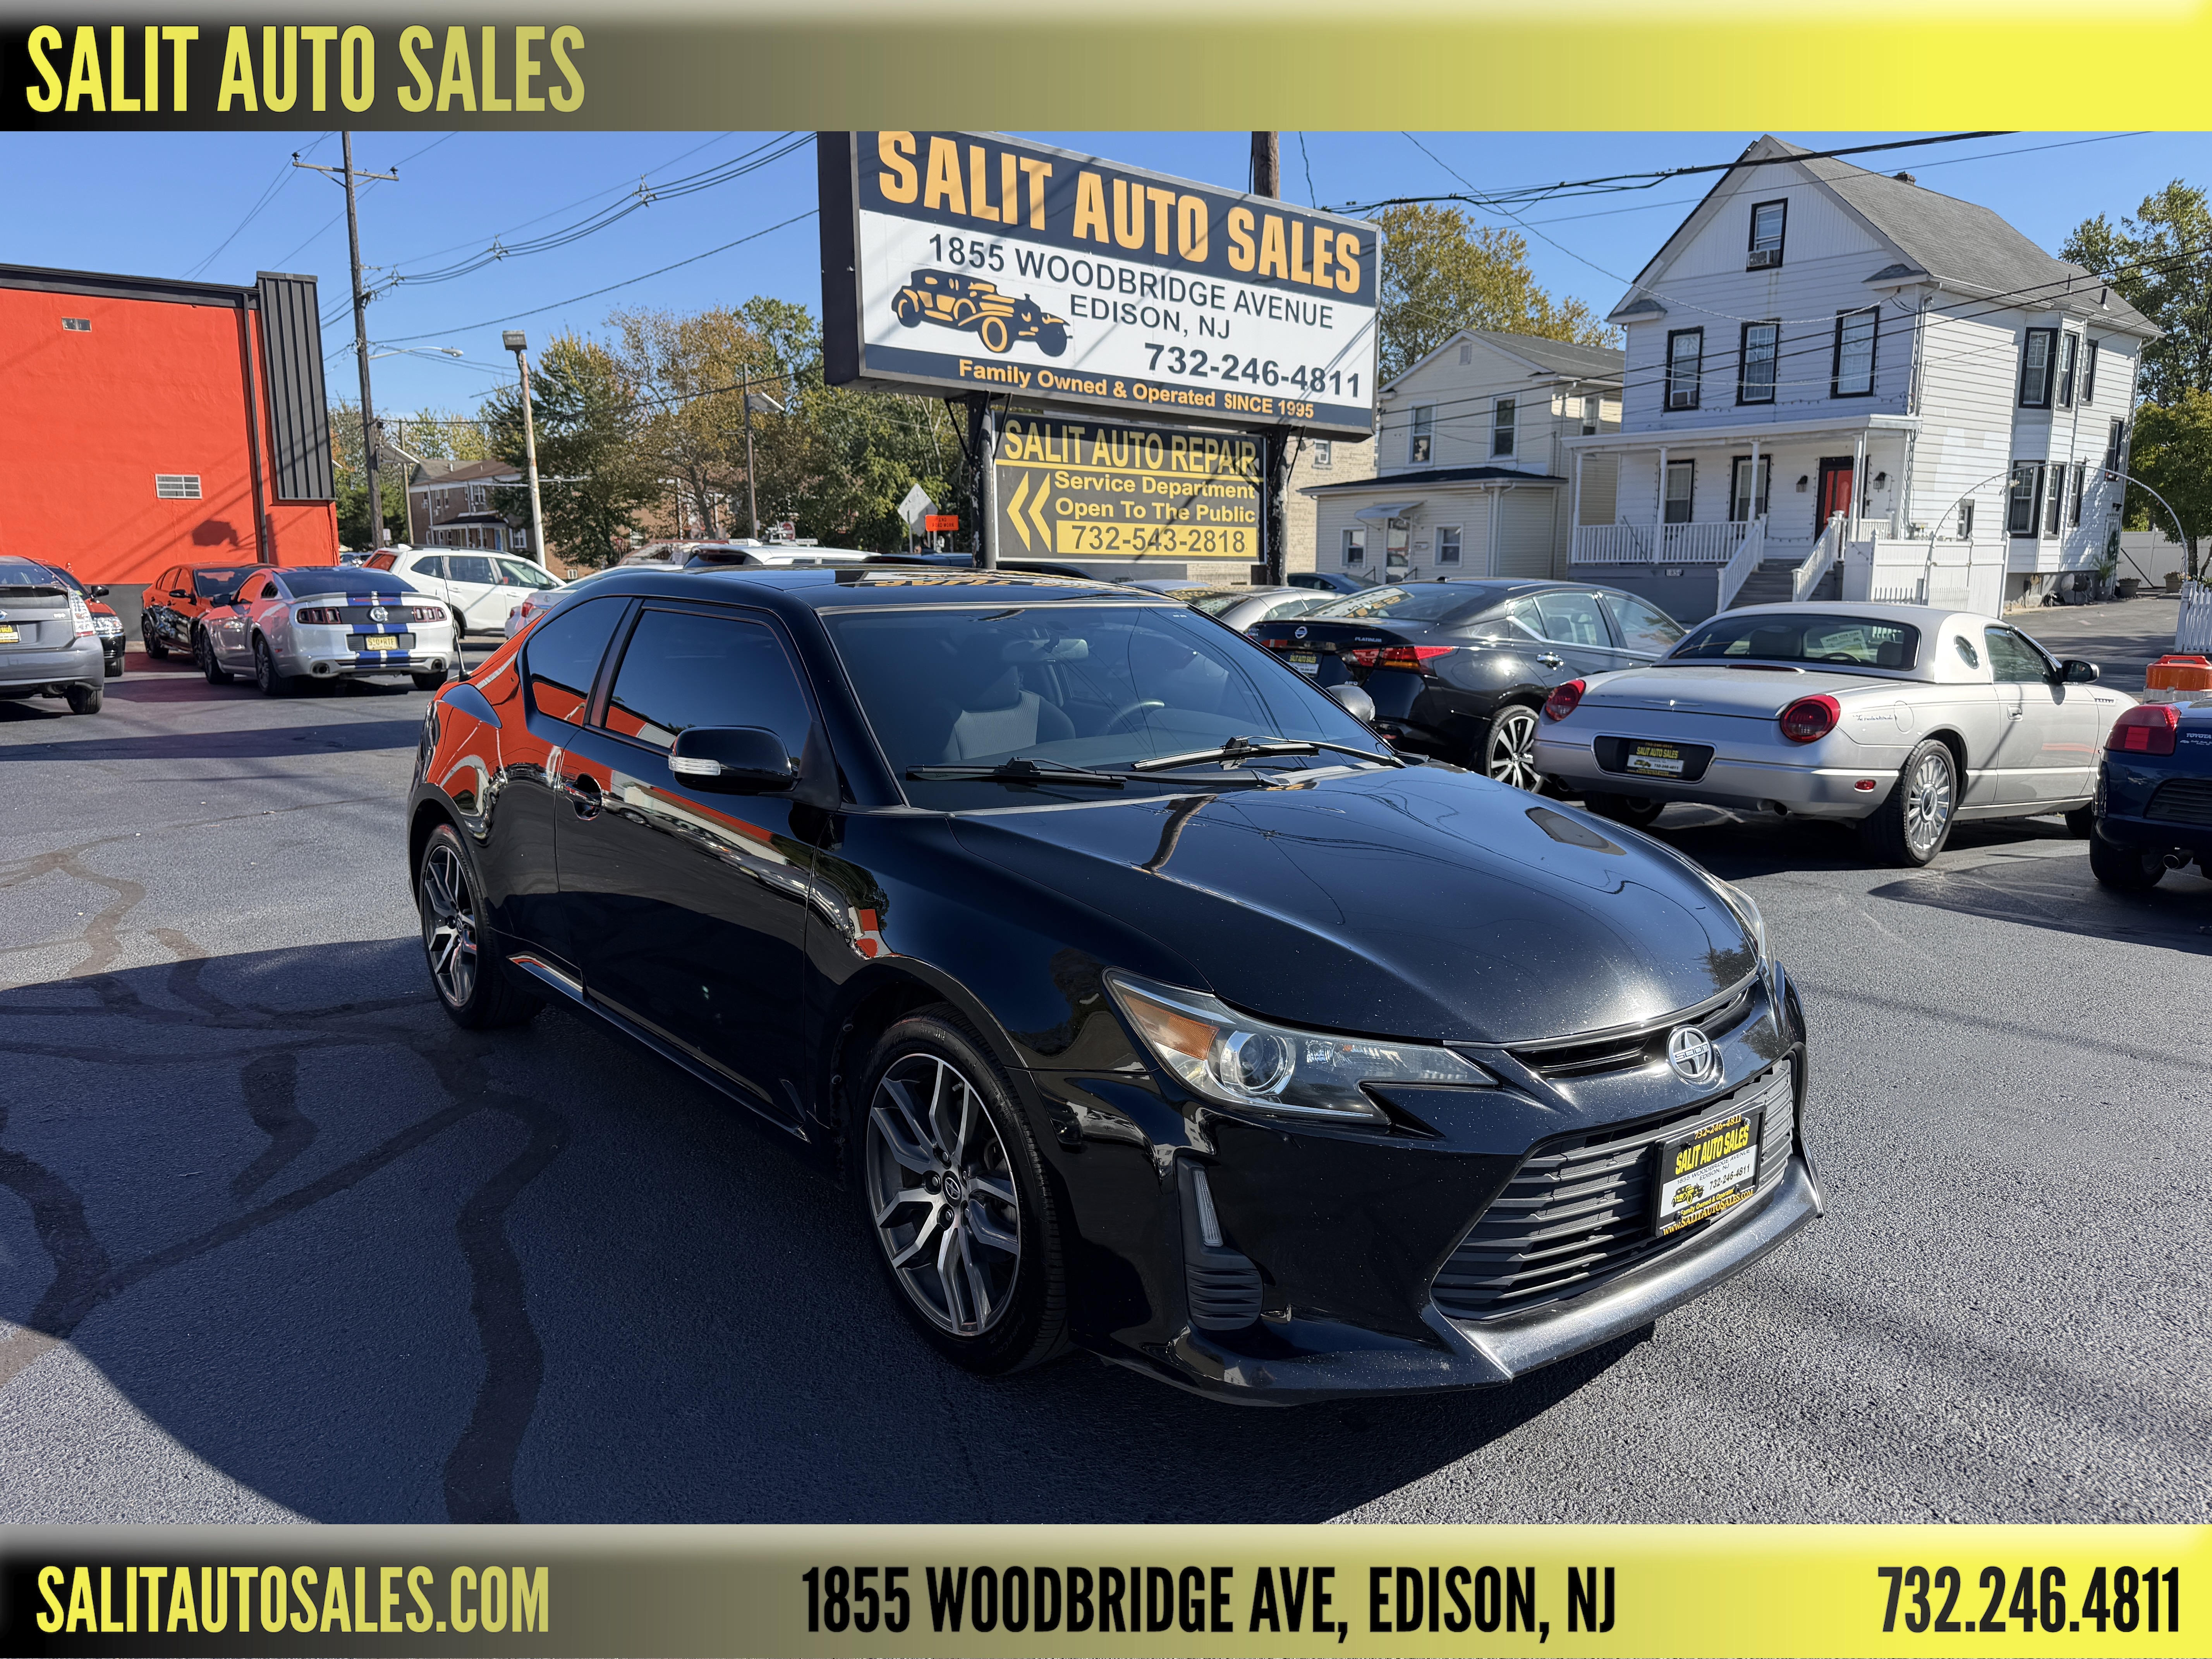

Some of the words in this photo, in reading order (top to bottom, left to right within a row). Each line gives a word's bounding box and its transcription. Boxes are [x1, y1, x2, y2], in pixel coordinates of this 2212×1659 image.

[878, 131, 1053, 231] SALIT
[1073, 171, 1209, 263] AUTO
[1228, 207, 1360, 294] SALES
[929, 233, 1005, 272] 1855
[1014, 248, 1225, 310] WOODBRIDGE
[1234, 290, 1333, 330] AVENUE
[1070, 294, 1189, 338] EDISON,
[1199, 315, 1230, 340] NJ
[1144, 342, 1359, 399] 732-246-4811
[958, 359, 1032, 389] Family
[1037, 369, 1107, 396] Owned
[1113, 381, 1128, 399] &
[1133, 386, 1216, 409] Operated
[1224, 394, 1273, 414] SINCE
[1278, 400, 1314, 419] 1995
[1005, 419, 1085, 464] SALIT
[1091, 428, 1164, 470] AUTO
[1172, 434, 1256, 477] REPAIR
[1054, 470, 1136, 493] Service
[1142, 476, 1255, 500] Department
[1055, 497, 1114, 520] Open
[1120, 500, 1146, 519] To
[1151, 502, 1190, 521] The
[1196, 504, 1255, 523] Public
[1072, 525, 1245, 553] 732-543-2818
[1636, 746, 1650, 756] SALIT
[1650, 748, 1663, 757] AUTO
[1663, 749, 1679, 759] SALES
[1675, 1043, 1709, 1061] SCION
[1694, 1114, 1741, 1140] 732-246-4811
[1675, 1144, 1701, 1175] SALIT
[1700, 1135, 1723, 1164] AUTO
[1724, 1125, 1750, 1154] SALES
[1692, 1158, 1729, 1178] WOODBRIDGE
[1730, 1148, 1751, 1161] AVENUE
[1699, 1168, 1722, 1181] EDISON,
[1710, 1163, 1750, 1190] 732-246-4811
[1696, 1197, 1712, 1210] Owned
